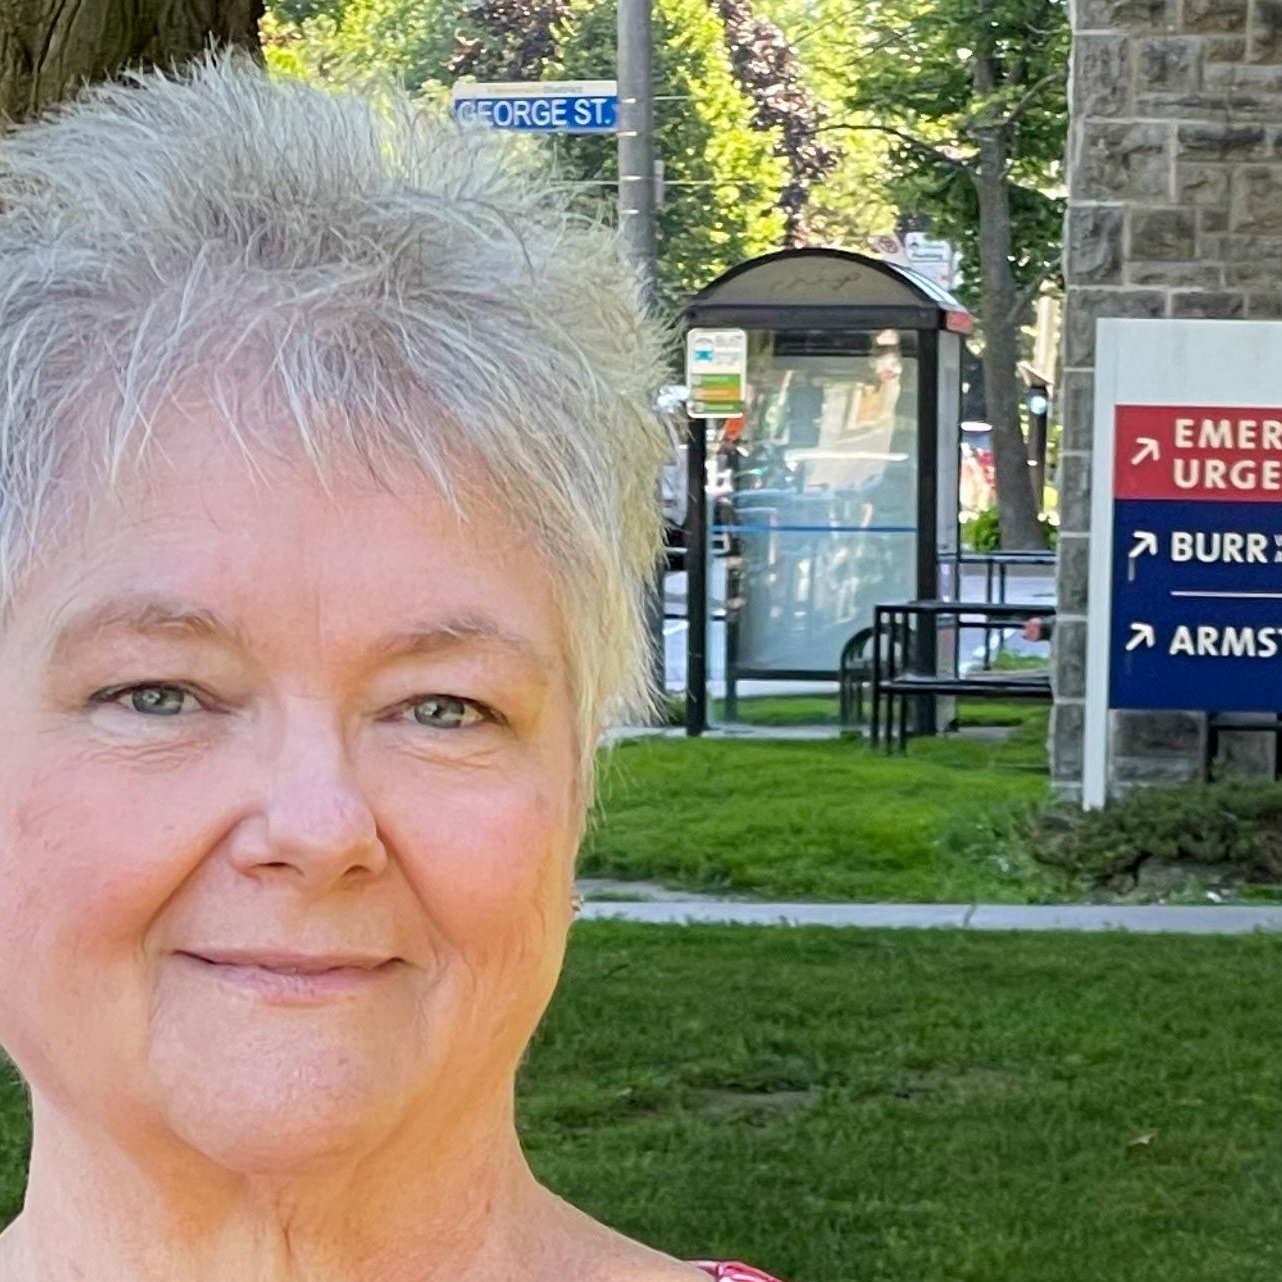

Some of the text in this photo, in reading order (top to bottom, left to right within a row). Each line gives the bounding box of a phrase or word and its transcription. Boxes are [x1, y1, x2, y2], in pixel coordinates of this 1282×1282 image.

[456, 98, 612, 127] GEORGE ST.
[1171, 532, 1268, 564] BURR
